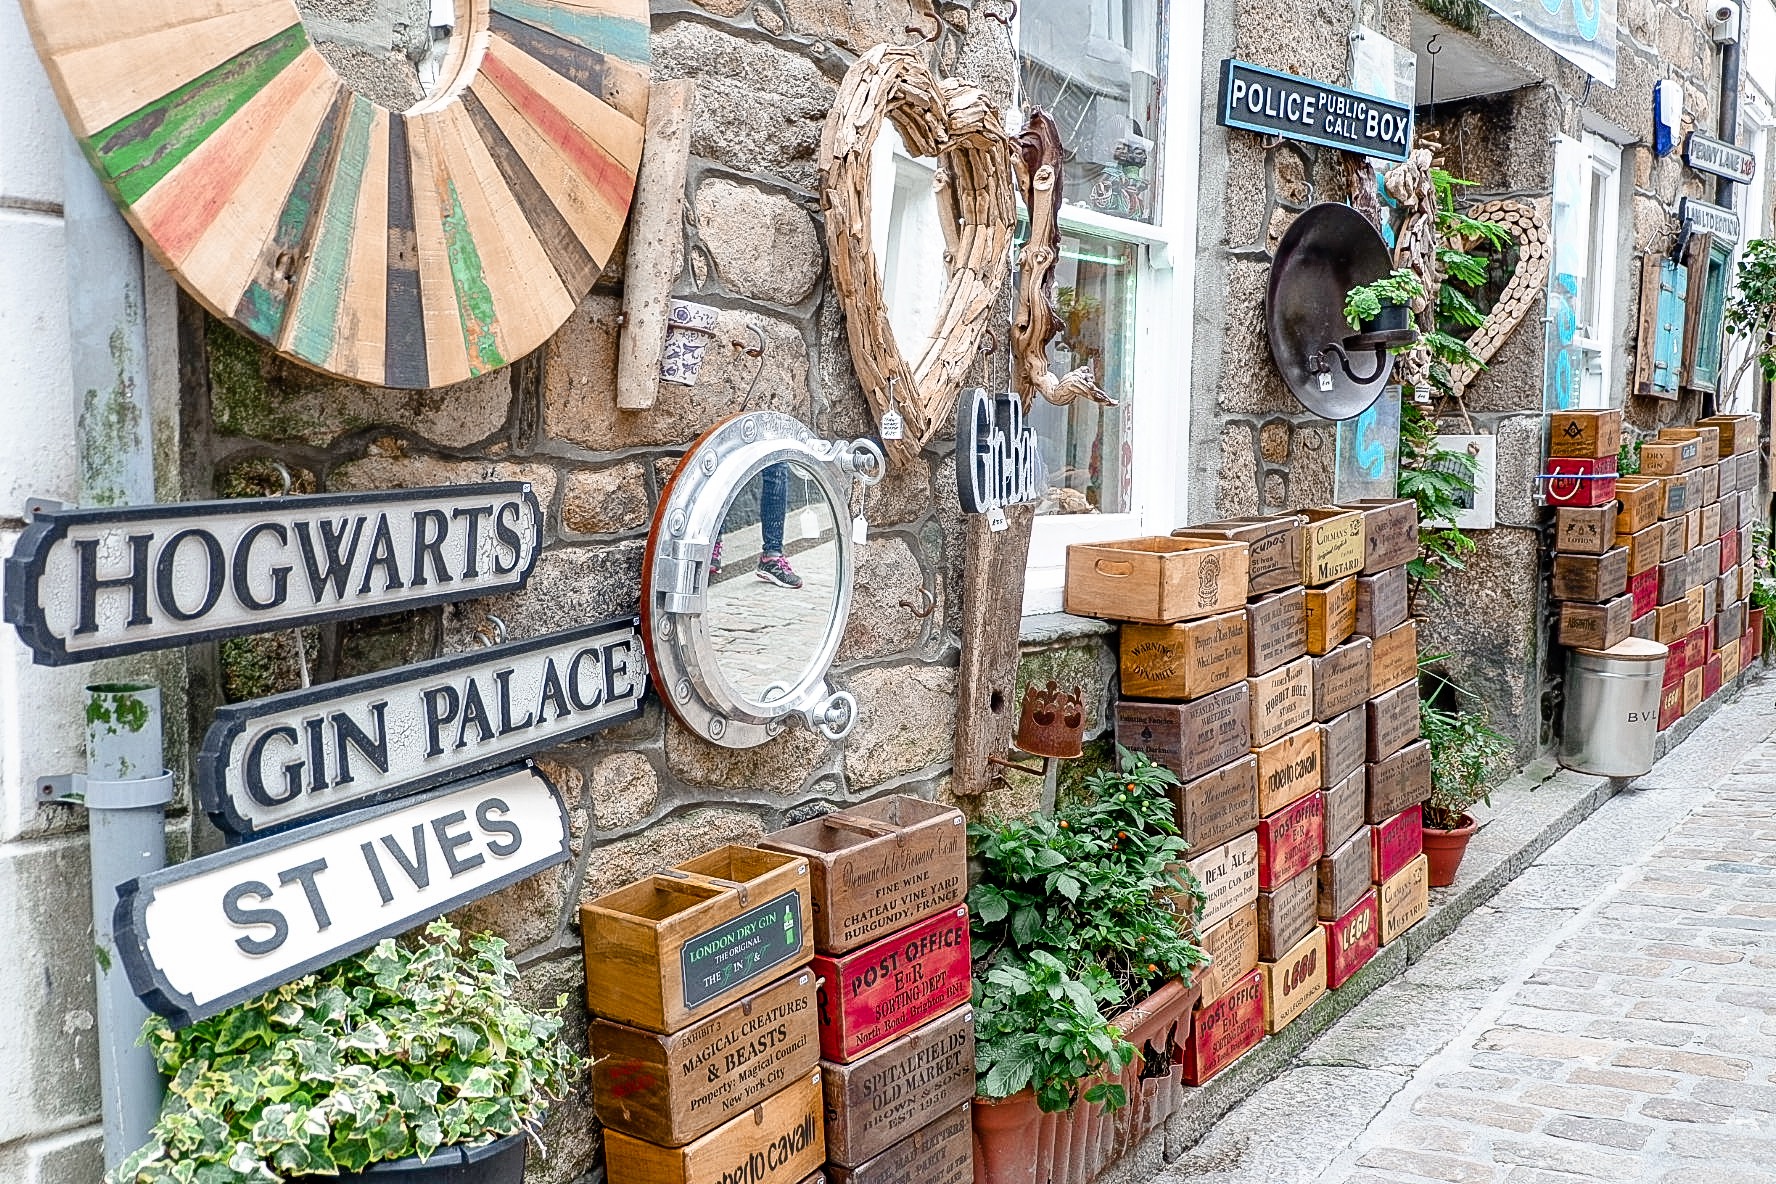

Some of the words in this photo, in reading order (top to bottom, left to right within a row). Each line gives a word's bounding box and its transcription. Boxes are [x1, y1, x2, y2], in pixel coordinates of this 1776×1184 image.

[1232, 79, 1316, 125] POLICE
[1318, 92, 1366, 120] PUBLIC
[1325, 115, 1358, 139] CALL
[1365, 109, 1408, 144] BOX
[1719, 149, 1740, 172] LANE
[1646, 452, 1665, 460] DRY
[1251, 533, 1286, 557] KUDOS
[1251, 559, 1260, 567] St
[1260, 556, 1274, 565] Ives
[73, 499, 525, 636] HOGWARTS
[1251, 561, 1279, 574] Cornwall
[1318, 558, 1359, 581] MUSTARD
[1131, 641, 1174, 660] WARNING
[1133, 664, 1177, 681] DYNAMITE
[1190, 699, 1221, 719] WEASLEY'S
[1265, 687, 1290, 716] HOBBIT
[1291, 685, 1308, 697] HOLE
[1279, 702, 1297, 718] STORES
[246, 700, 391, 808] GIN
[421, 640, 636, 758] PALACE
[1268, 764, 1294, 794] roberto
[1294, 751, 1317, 781] cavalli
[1274, 815, 1294, 844] POST
[1295, 802, 1319, 824] OFFICE
[221, 857, 332, 958] ST
[360, 797, 524, 906] IVES
[875, 881, 900, 899] FINE
[903, 871, 930, 888] WINE
[1205, 863, 1228, 886] REAL
[1231, 850, 1247, 871] ALE
[843, 898, 898, 928] CHATEAU
[901, 887, 928, 906] VINE
[931, 876, 959, 895] YARD
[844, 908, 914, 941] BURGUNDY,
[916, 888, 959, 913] FRANCE
[1204, 906, 1214, 919] rewed
[1387, 901, 1423, 936] MUSTARD
[689, 932, 735, 963] LONDON
[737, 920, 757, 941] DRY
[758, 912, 777, 929] GIN
[714, 951, 729, 964] THE
[729, 935, 762, 957] ORIGINAL
[1342, 907, 1371, 951] LEGO
[703, 971, 721, 987] THE
[733, 960, 744, 973] IN
[851, 951, 899, 997] POST
[905, 926, 964, 962] OFFICE
[1283, 947, 1317, 997] LEGO
[856, 1025, 881, 1046] North
[910, 993, 945, 1017] Brighton
[947, 982, 963, 999] BN1
[875, 986, 920, 1021] SORTING
[922, 971, 947, 997] DEPT
[1200, 1001, 1225, 1038] POST
[1228, 983, 1260, 1011] OFFICE
[1290, 998, 1304, 1014] LEGO
[682, 1022, 717, 1048] EXHIBIT
[716, 1021, 722, 1032] 3
[682, 1030, 739, 1077] MAGICAL
[741, 996, 808, 1036] CREATURES
[707, 1063, 721, 1083] &
[724, 1023, 787, 1074] BEASTS
[690, 1079, 736, 1111] Property:
[738, 1054, 774, 1084] Magical
[775, 1034, 807, 1061] Council
[863, 1028, 966, 1098] SPITALFIELDS
[872, 1087, 901, 1112] OLD
[906, 1050, 962, 1095] MARKET
[721, 1093, 742, 1112] New
[744, 1079, 766, 1098] York
[767, 1067, 785, 1084] City
[863, 1095, 916, 1132] BROWN
[921, 1087, 931, 1099] &
[934, 1064, 970, 1090] SONS
[888, 1107, 916, 1130] EST
[919, 1090, 948, 1111] 1936
[768, 1110, 816, 1172] cavalli
